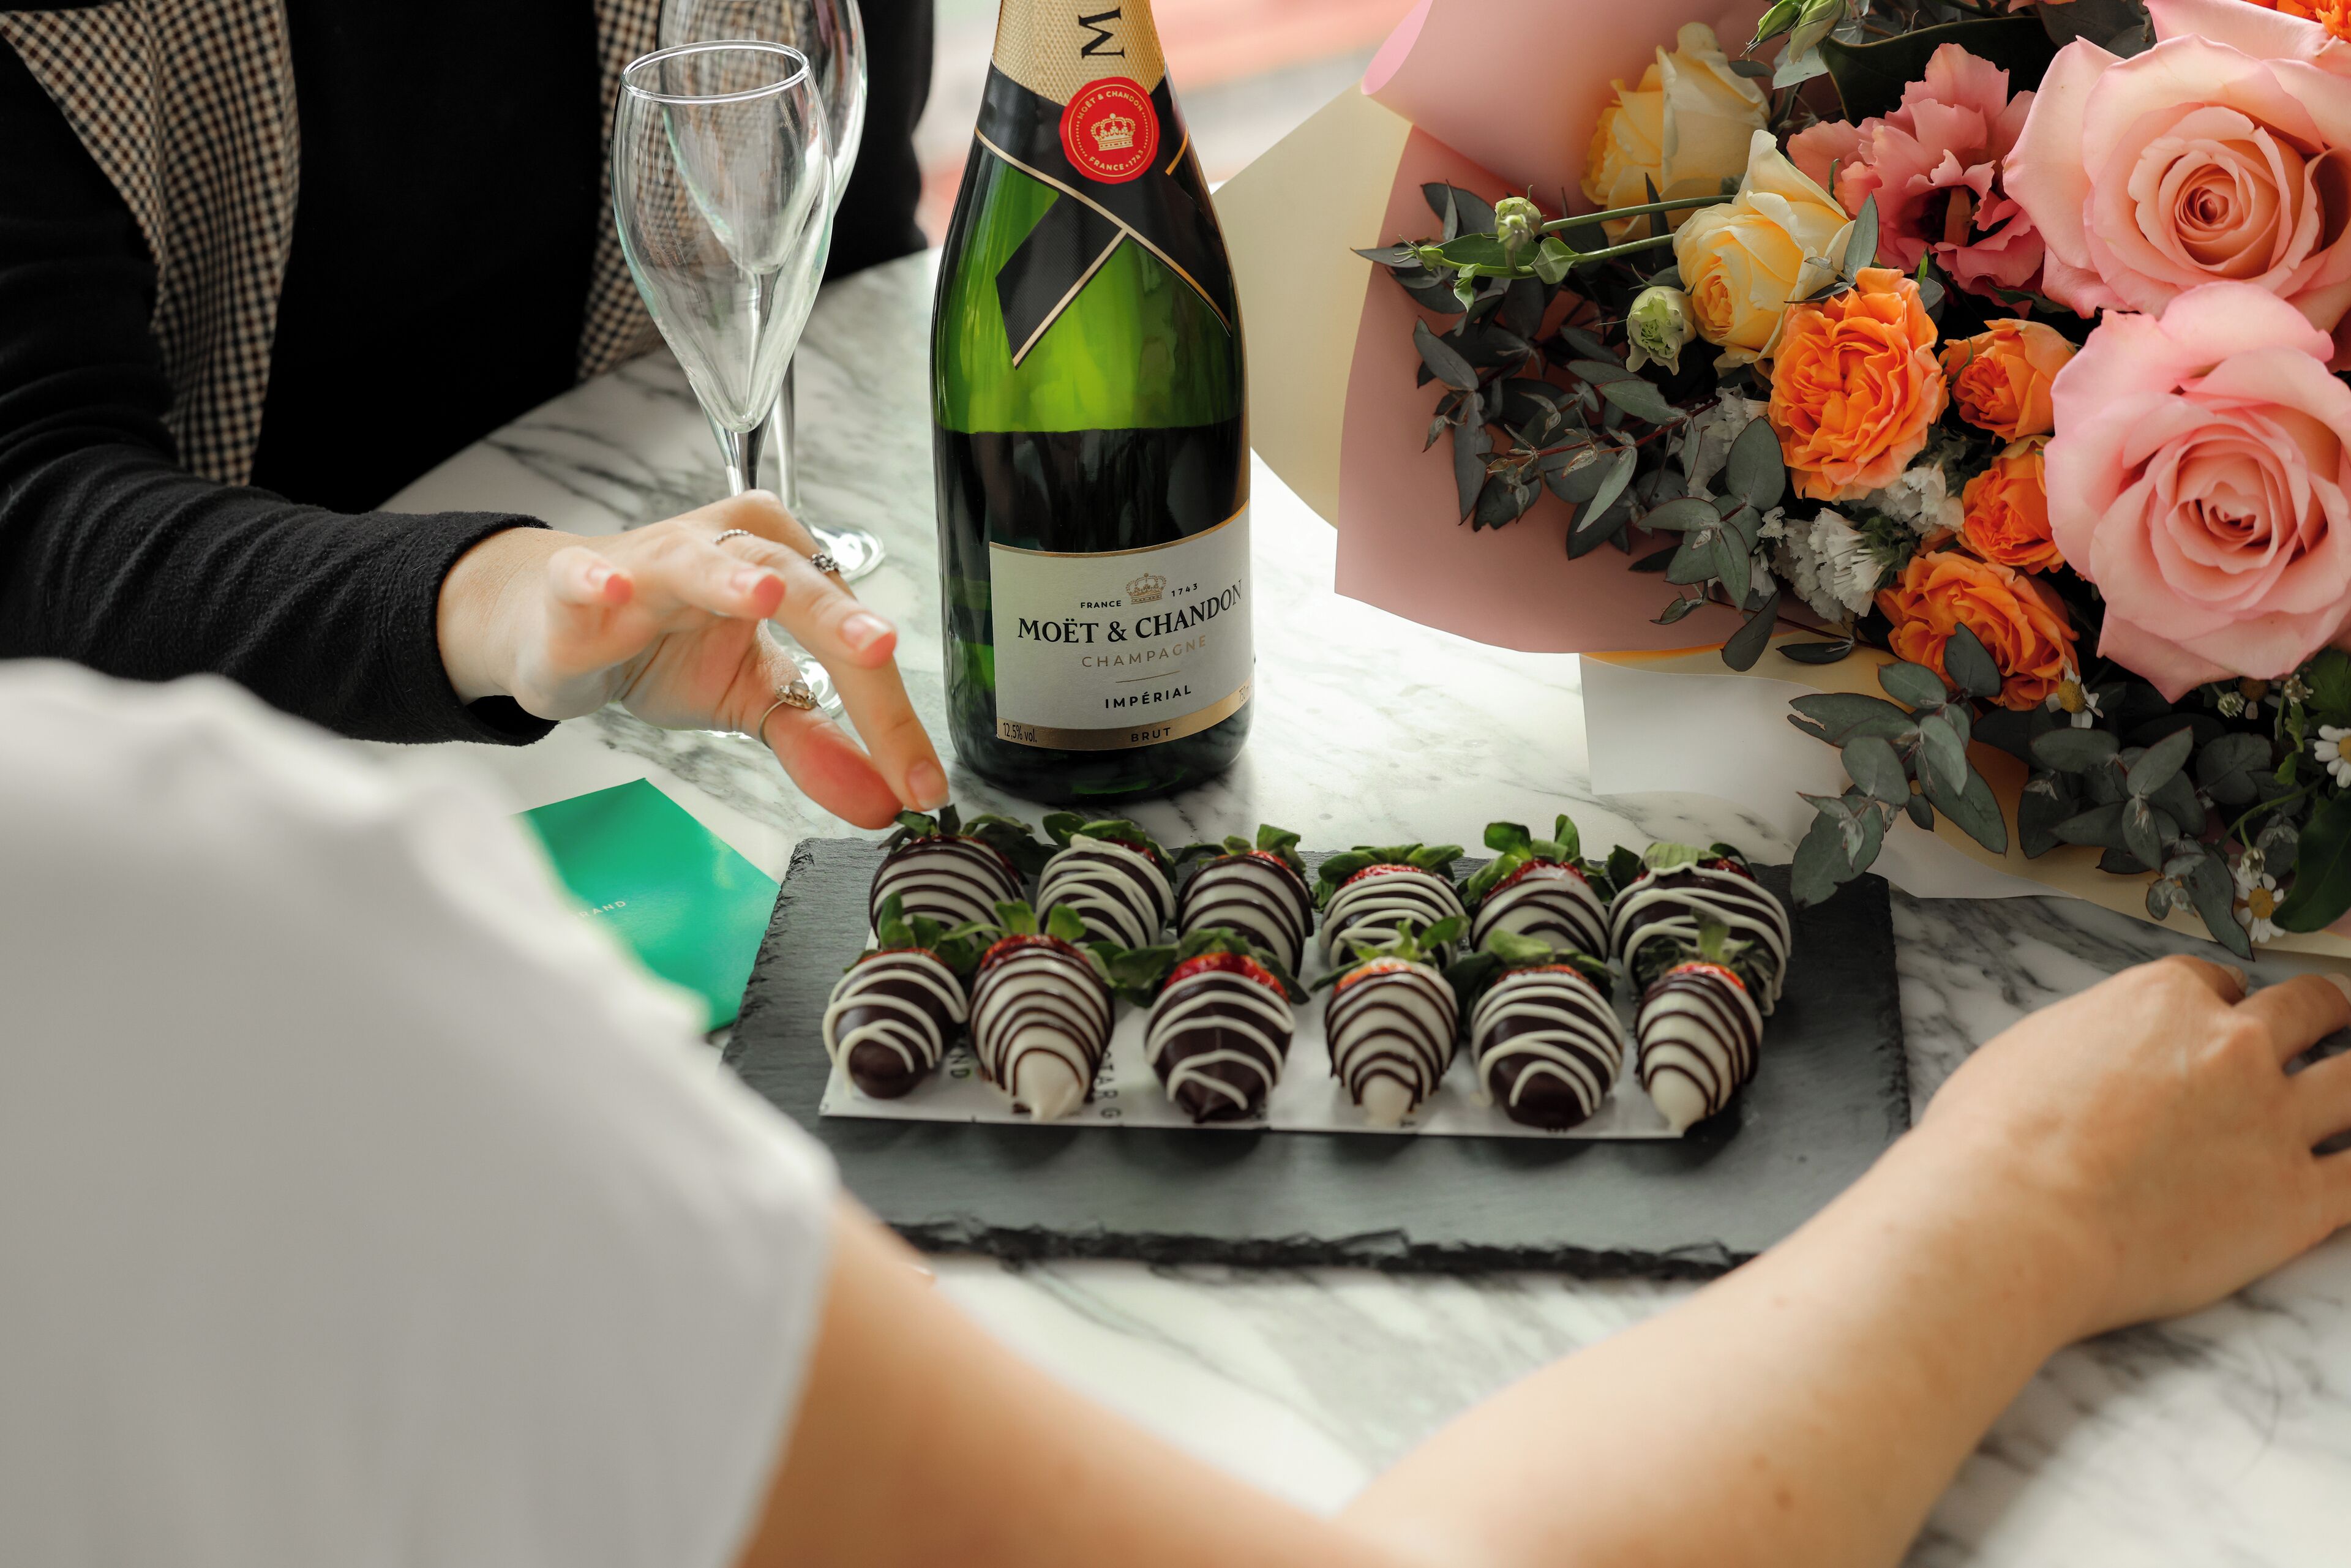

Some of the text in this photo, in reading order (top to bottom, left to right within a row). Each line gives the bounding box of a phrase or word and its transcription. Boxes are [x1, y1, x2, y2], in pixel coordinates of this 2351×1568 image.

[1106, 91, 1144, 112] CHANDON
[1089, 156, 1124, 171] FRANCE
[1171, 582, 1199, 598] 1743
[1018, 578, 1243, 643] MOËT & CHANDON
[1080, 600, 1122, 609] FRANCE
[1082, 634, 1207, 668] CHAMPAGNE
[1105, 685, 1192, 709] IMPÉRIAL
[1003, 722, 1038, 744] 12,5% vol.
[1131, 727, 1171, 743] BRUT
[578, 901, 626, 917] RAND
